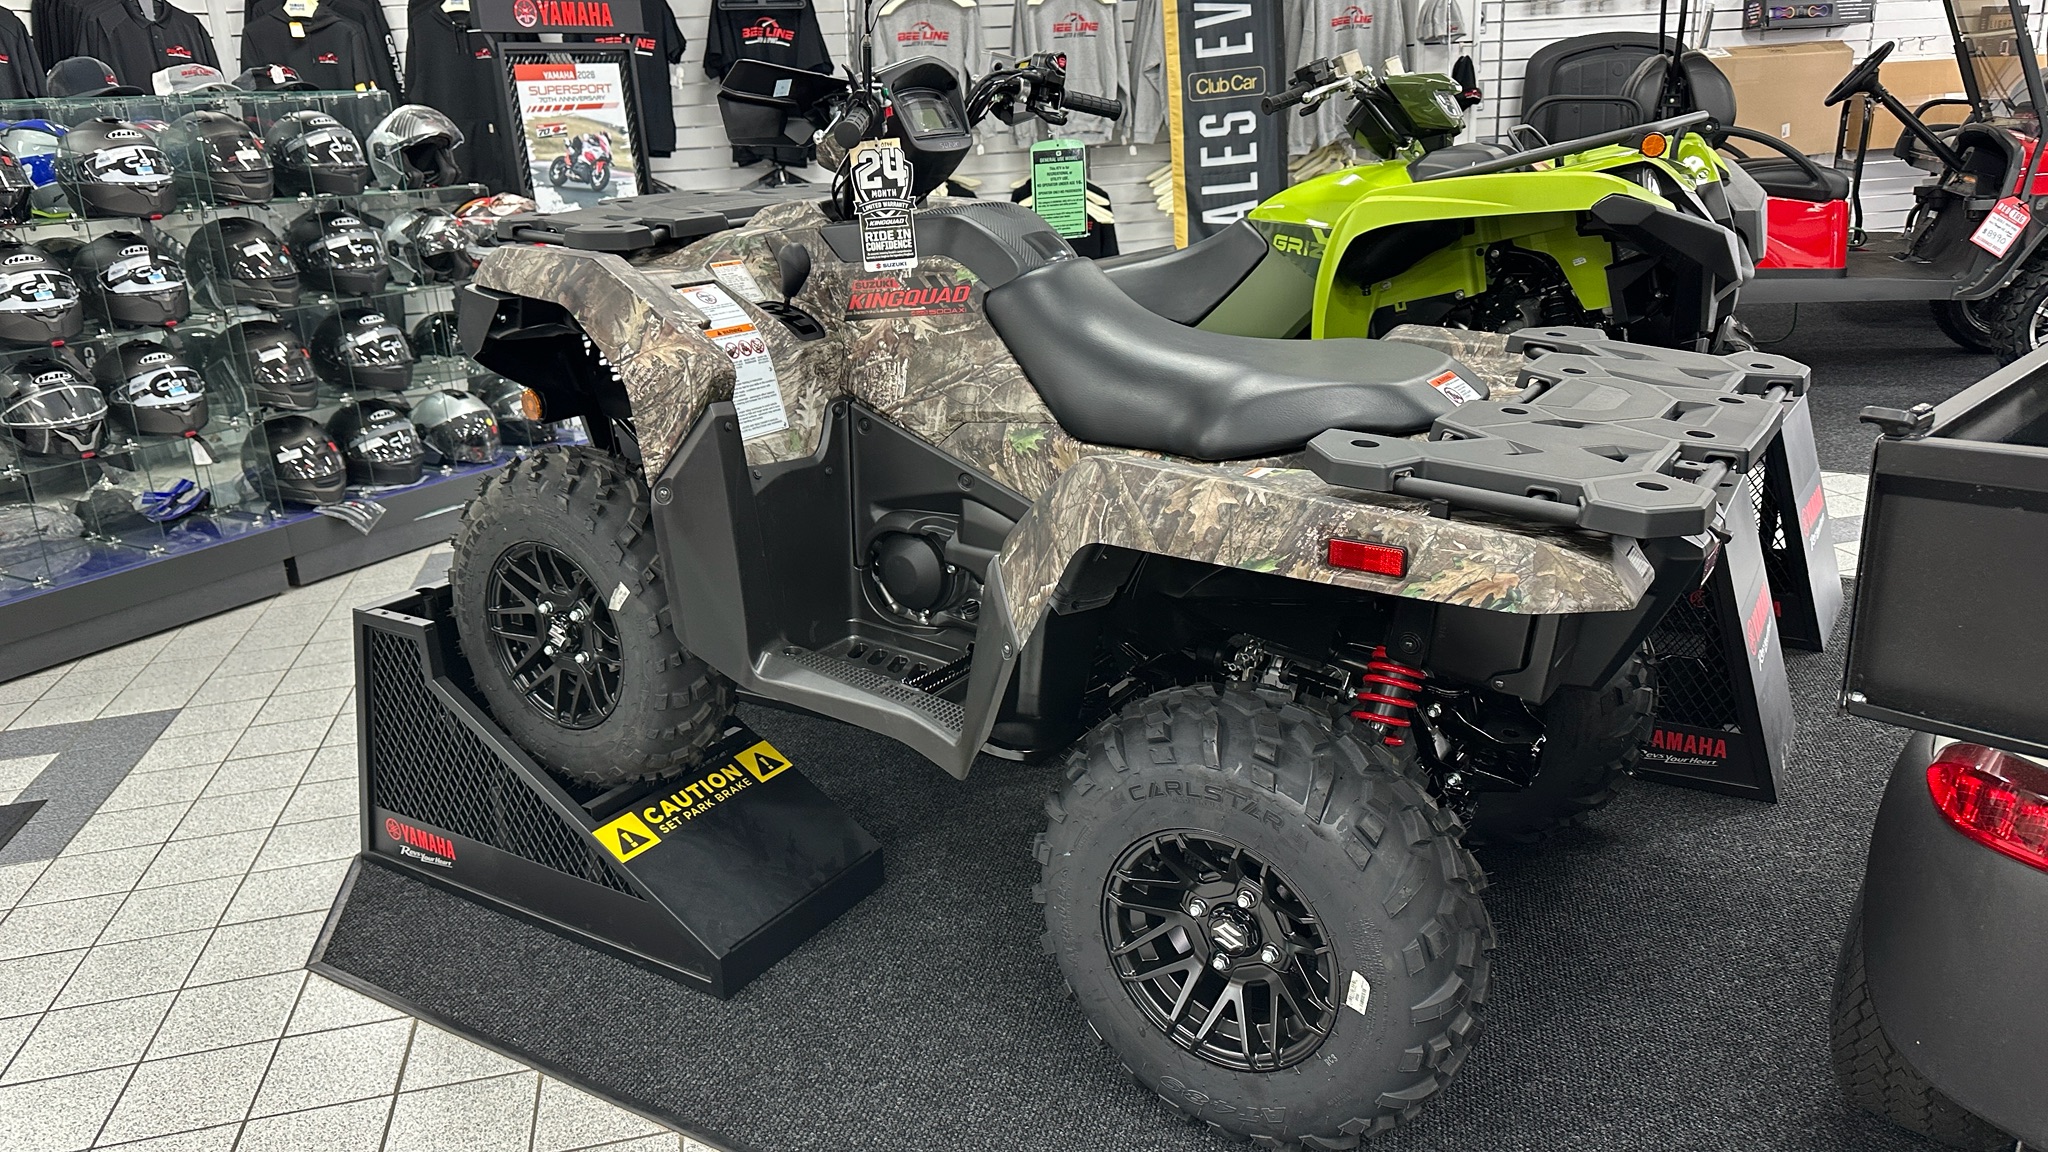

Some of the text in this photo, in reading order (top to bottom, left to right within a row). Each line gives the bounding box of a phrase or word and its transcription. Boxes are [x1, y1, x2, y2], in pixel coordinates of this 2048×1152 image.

[539, 1, 614, 27] YAMAHA
[742, 27, 763, 38] BEE
[765, 27, 795, 41] LINE
[897, 31, 950, 42] BEE LINE
[542, 70, 576, 80] YAMAHA
[529, 83, 612, 96] SUPERSPORT
[1196, 76, 1257, 95] Club Car
[858, 149, 907, 189] 24
[1200, 110, 1259, 225] ALES
[871, 189, 898, 199] MONTH
[864, 229, 912, 242] RIDE IN
[865, 239, 913, 252] CONFIDENCE
[882, 261, 908, 269] SUZUKI
[855, 279, 895, 290] SUZUKI
[848, 285, 971, 311] KINGQUAD
[38, 371, 70, 383] HJC
[1651, 729, 1728, 759] AMAHA
[643, 763, 744, 824] CAUTION
[658, 777, 753, 834] SET PARK BRAKE
[1128, 780, 1286, 832] CARLSTAR
[400, 823, 457, 860] YAMAHA
